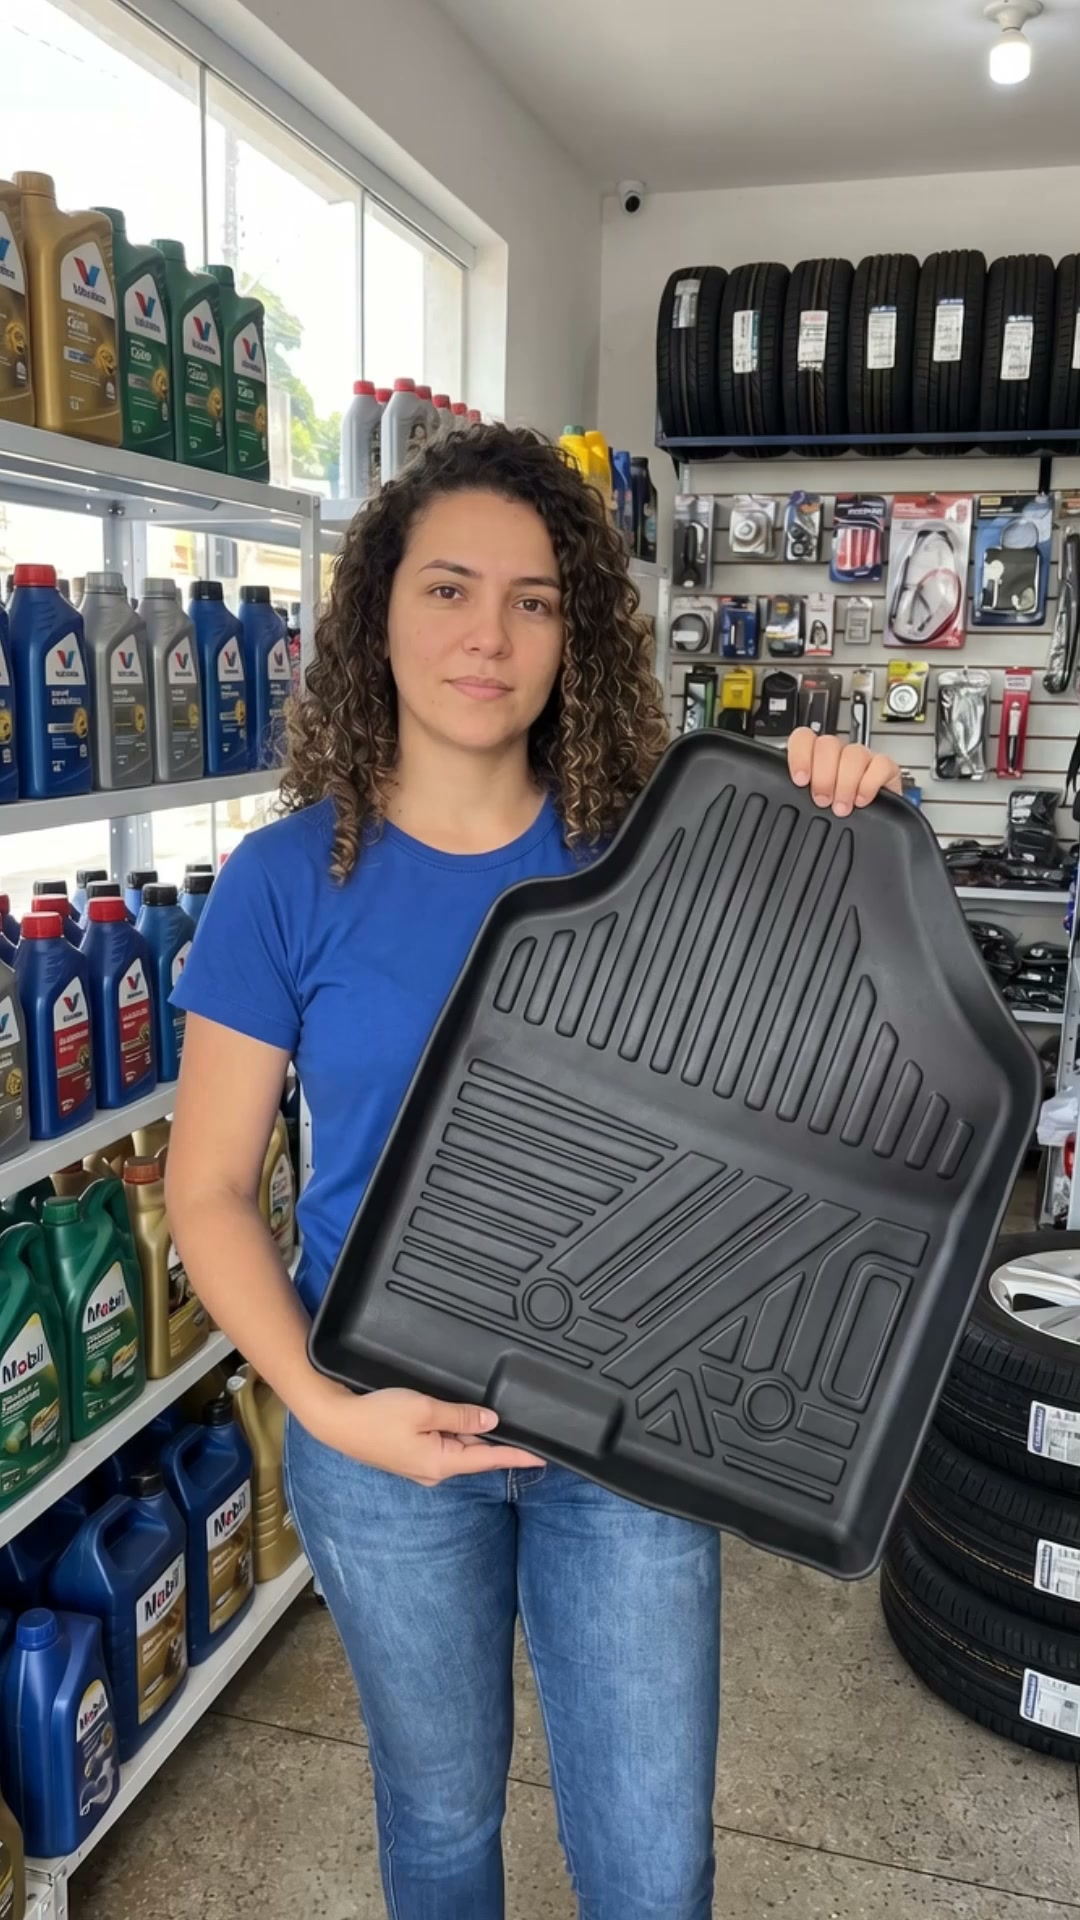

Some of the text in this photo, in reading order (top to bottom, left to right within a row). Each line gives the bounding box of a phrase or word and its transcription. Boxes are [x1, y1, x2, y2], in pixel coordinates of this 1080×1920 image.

[2, 1344, 44, 1384] Mobil
[213, 1492, 246, 1538] Mobil
[143, 1565, 180, 1622] Mobil
